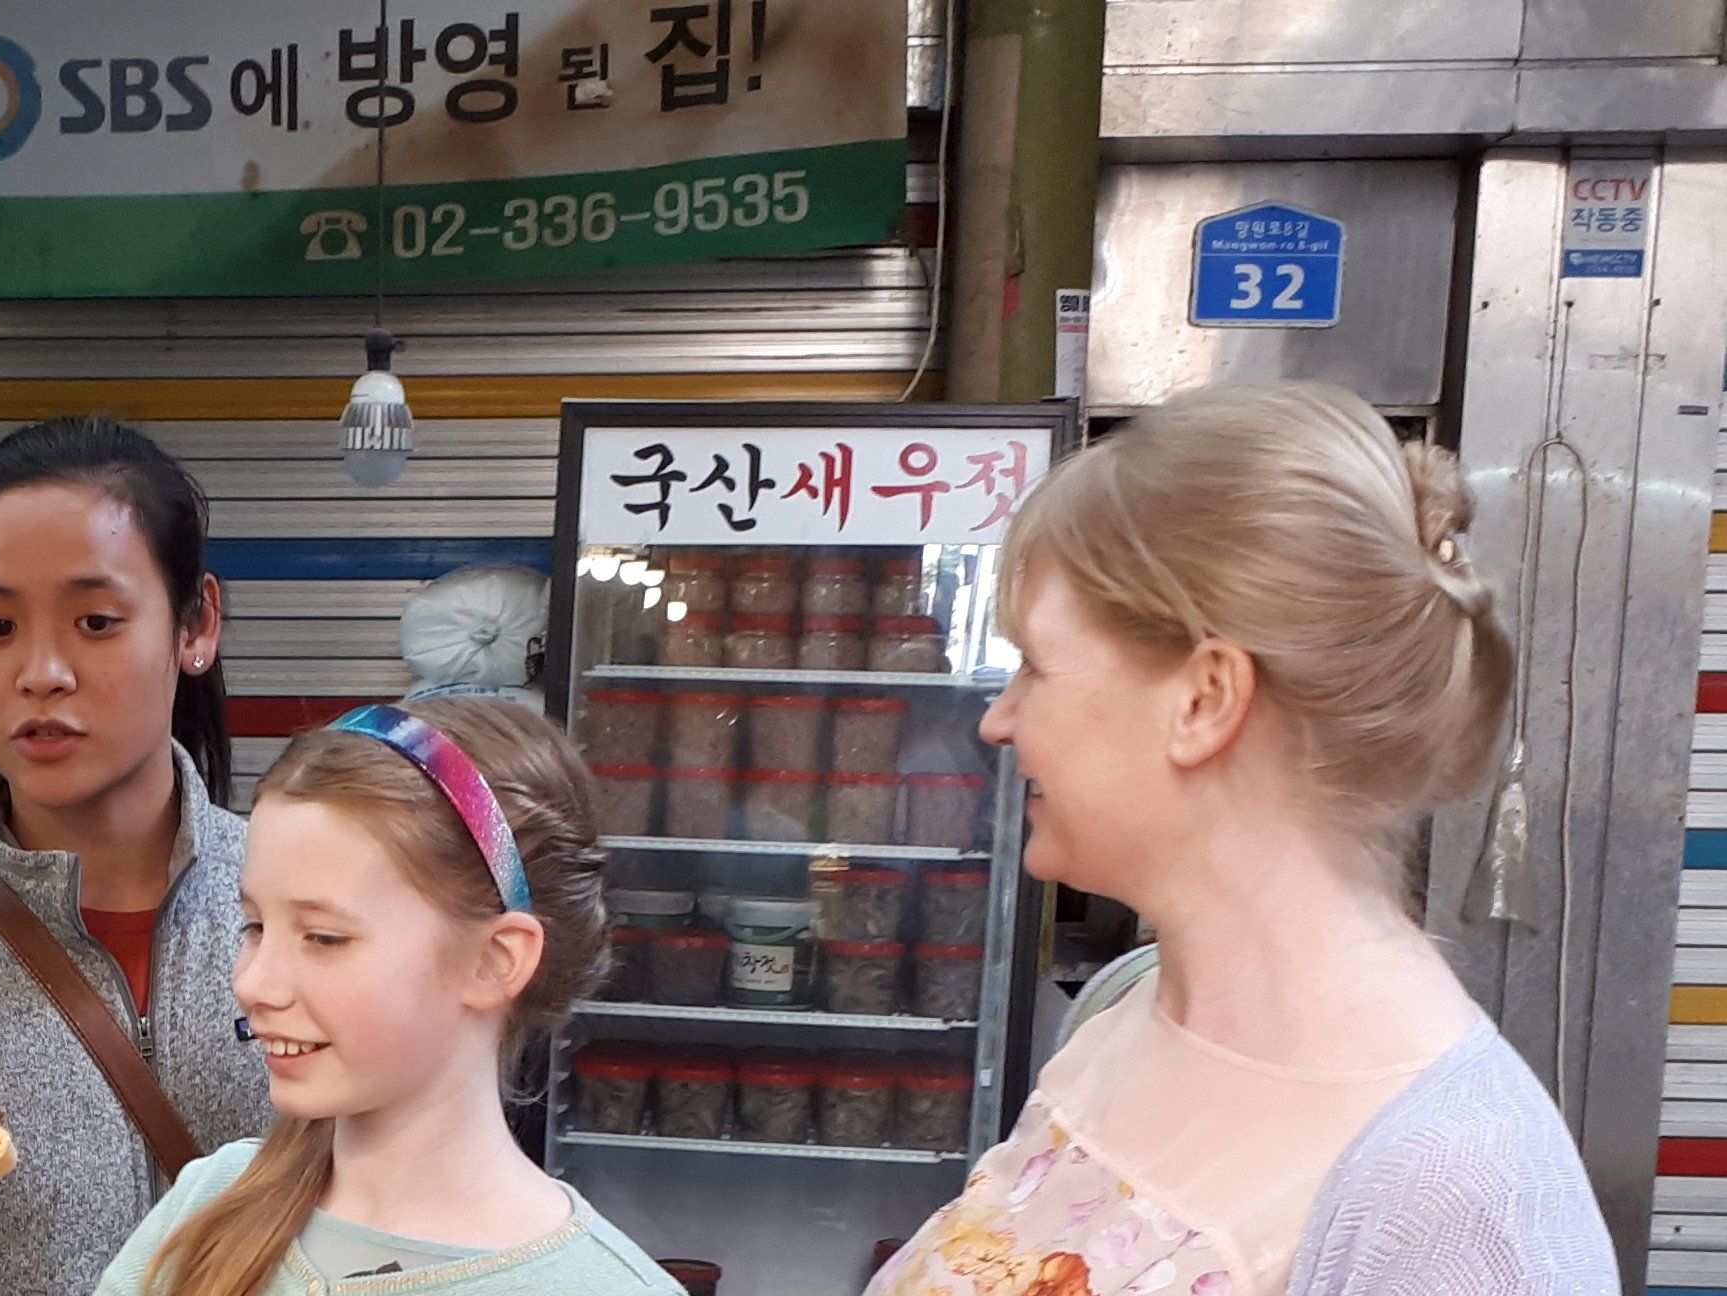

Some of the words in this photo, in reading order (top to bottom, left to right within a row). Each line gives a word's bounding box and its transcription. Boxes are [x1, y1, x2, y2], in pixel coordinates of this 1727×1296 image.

[337, 11, 520, 129] 방영
[1573, 178, 1648, 201] CCTV
[392, 168, 810, 260] 02-336-9535
[1571, 207, 1645, 232] 작동중
[1228, 262, 1306, 310] 32
